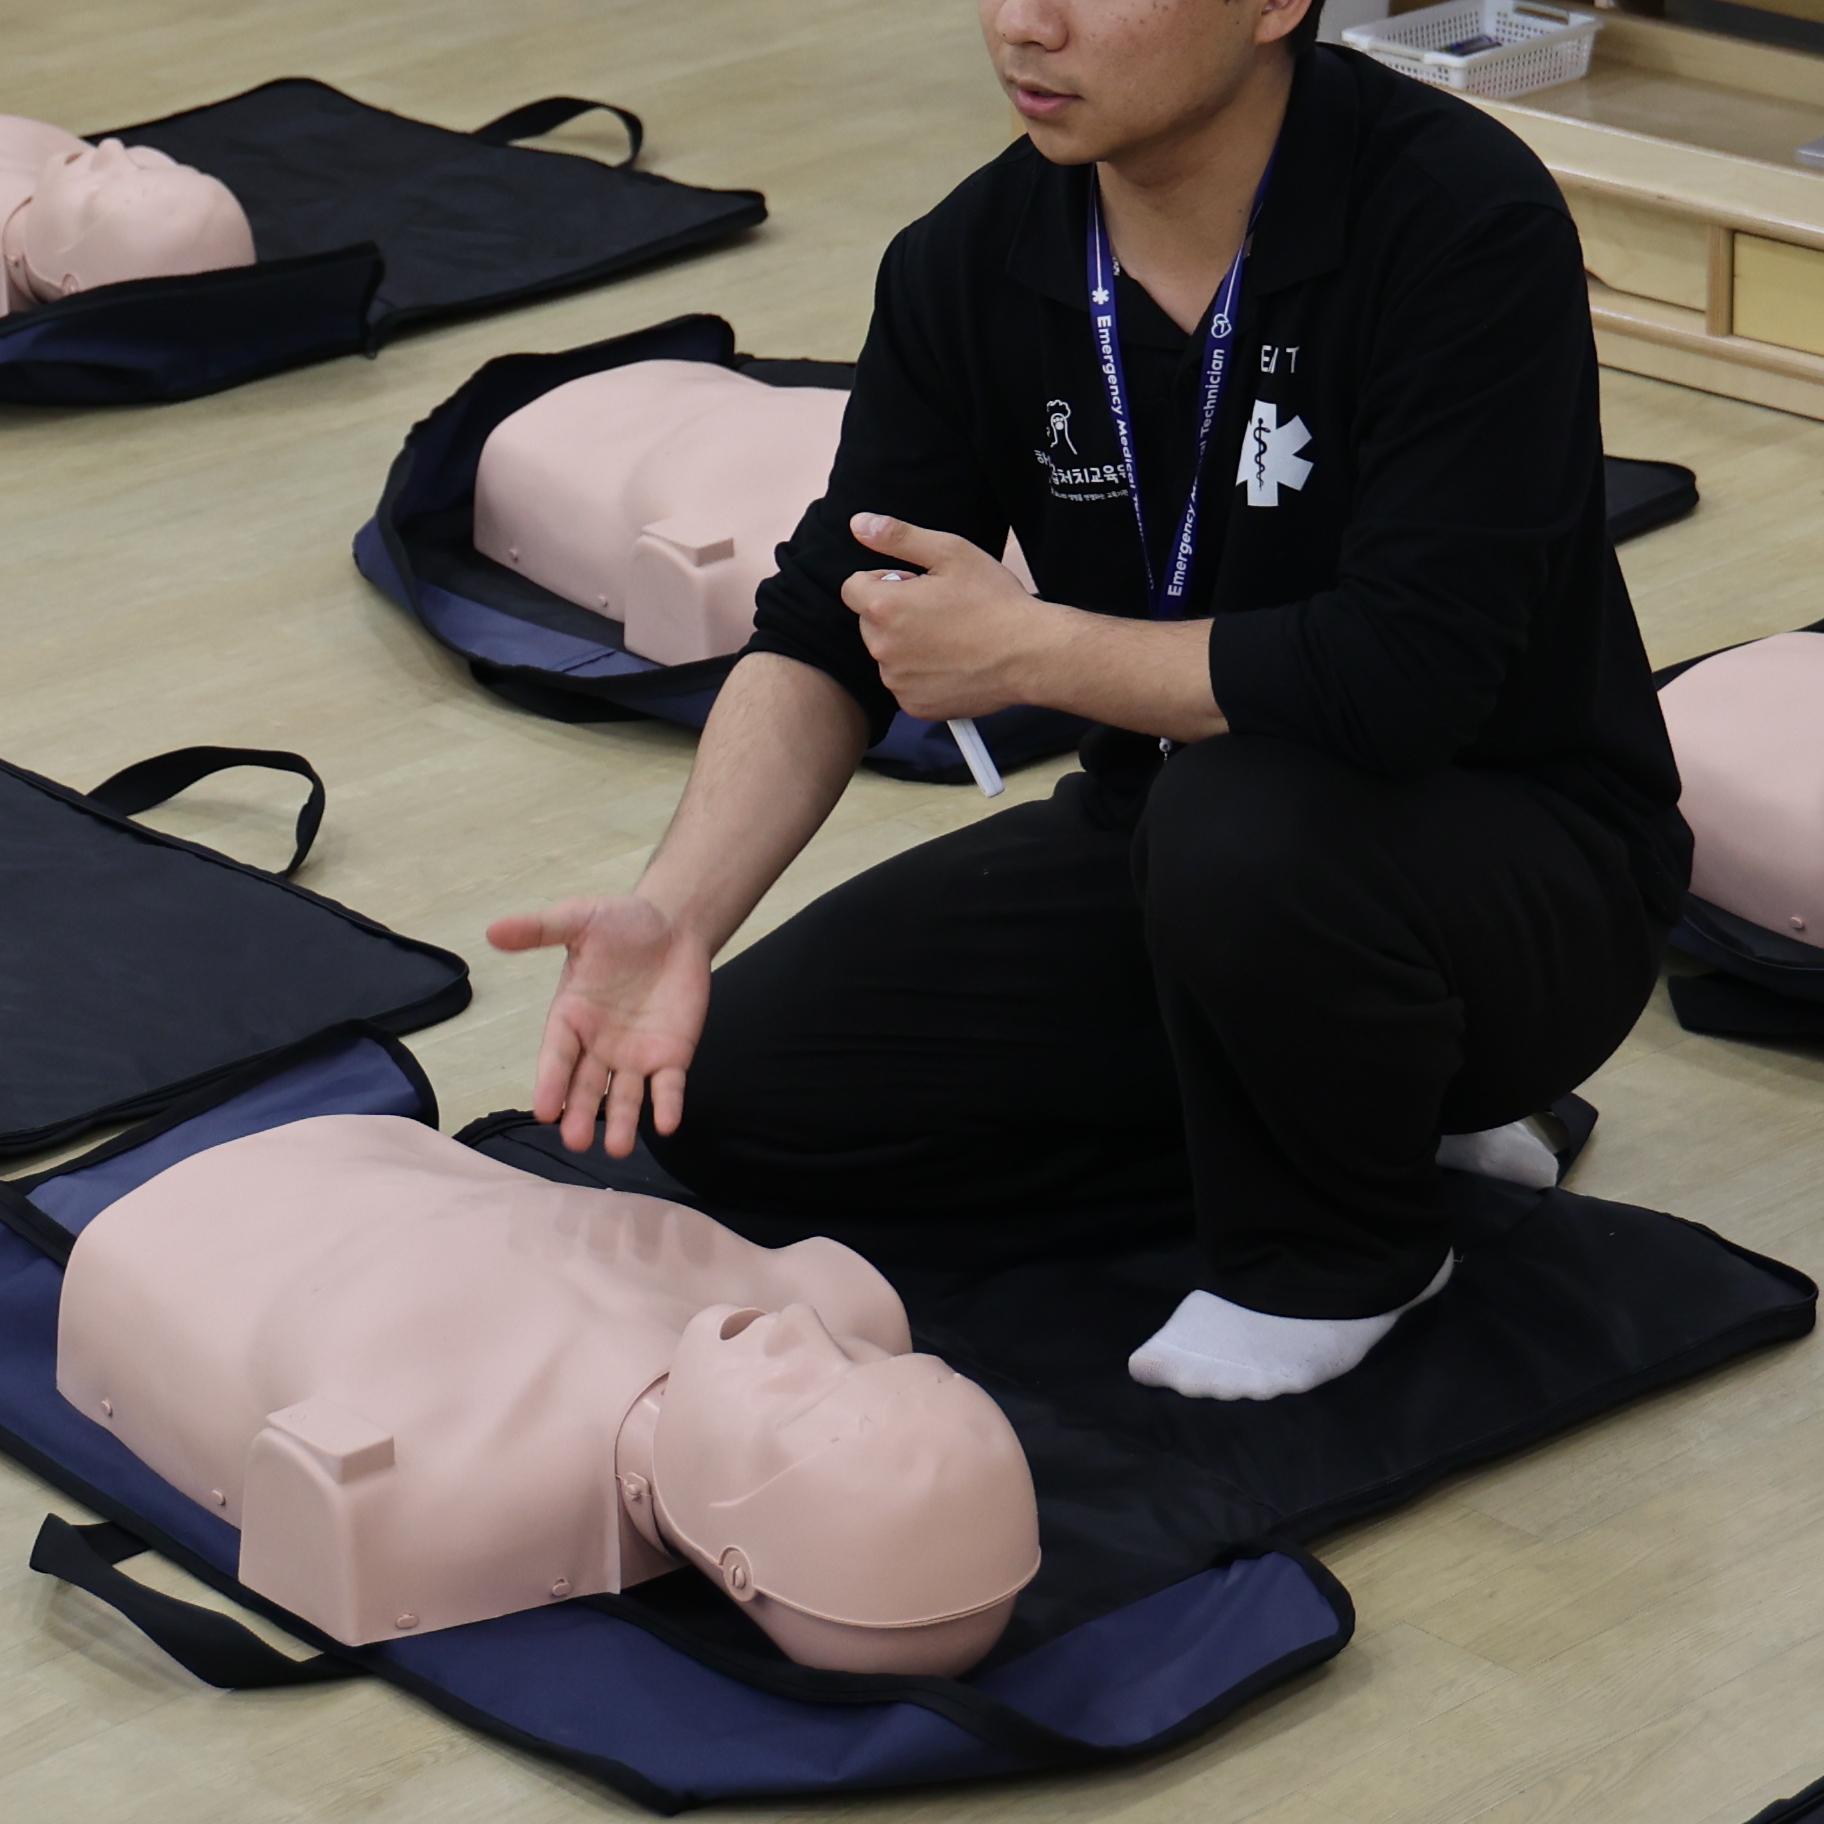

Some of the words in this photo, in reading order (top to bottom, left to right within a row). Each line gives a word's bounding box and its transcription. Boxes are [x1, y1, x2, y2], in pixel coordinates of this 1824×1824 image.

[1096, 314, 1124, 416] Emergency
[1116, 418, 1137, 490] Medical
[1260, 344, 1301, 374] ET
[1167, 503, 1196, 597] Emergency
[1200, 348, 1225, 437] Technician
